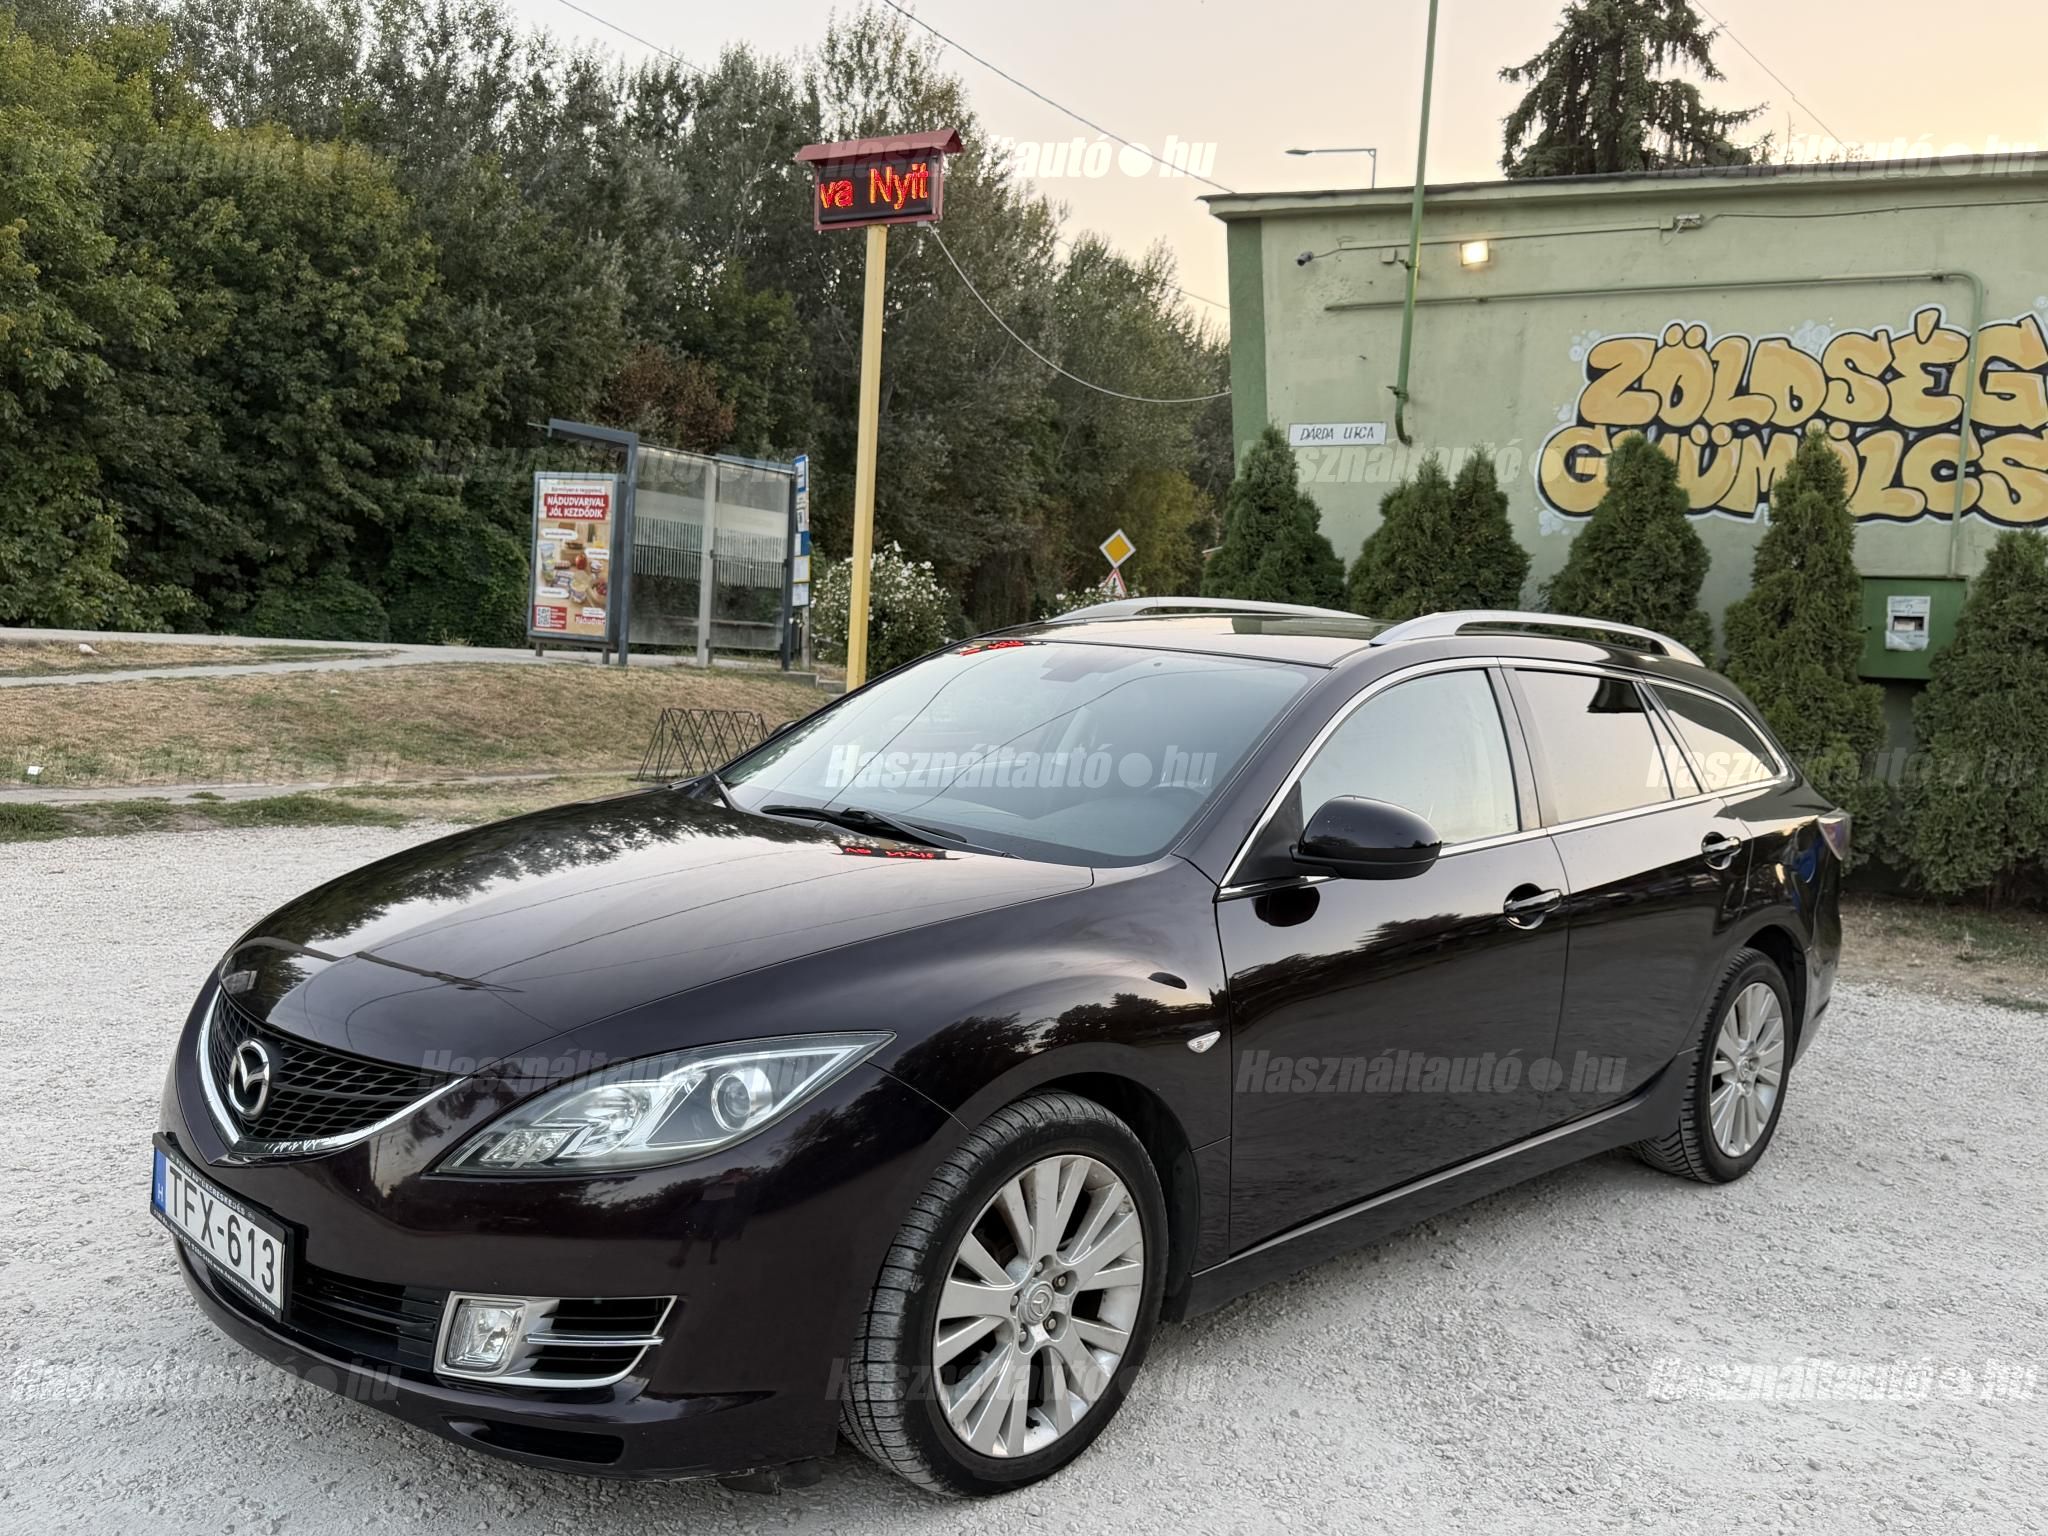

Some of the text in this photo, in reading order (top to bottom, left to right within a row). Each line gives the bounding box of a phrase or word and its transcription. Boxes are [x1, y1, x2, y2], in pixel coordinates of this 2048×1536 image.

[820, 162, 929, 210] va Nyit
[1579, 307, 2048, 431] ZÖLDSÉG
[1300, 426, 1375, 441] DÁRDA UTCA
[1538, 418, 2048, 525] GÜMLCS
[547, 494, 606, 507] NÁDUDVARIVAL
[548, 505, 563, 517] JÓL
[157, 1183, 164, 1201] H
[169, 1165, 275, 1294] TFX-613
